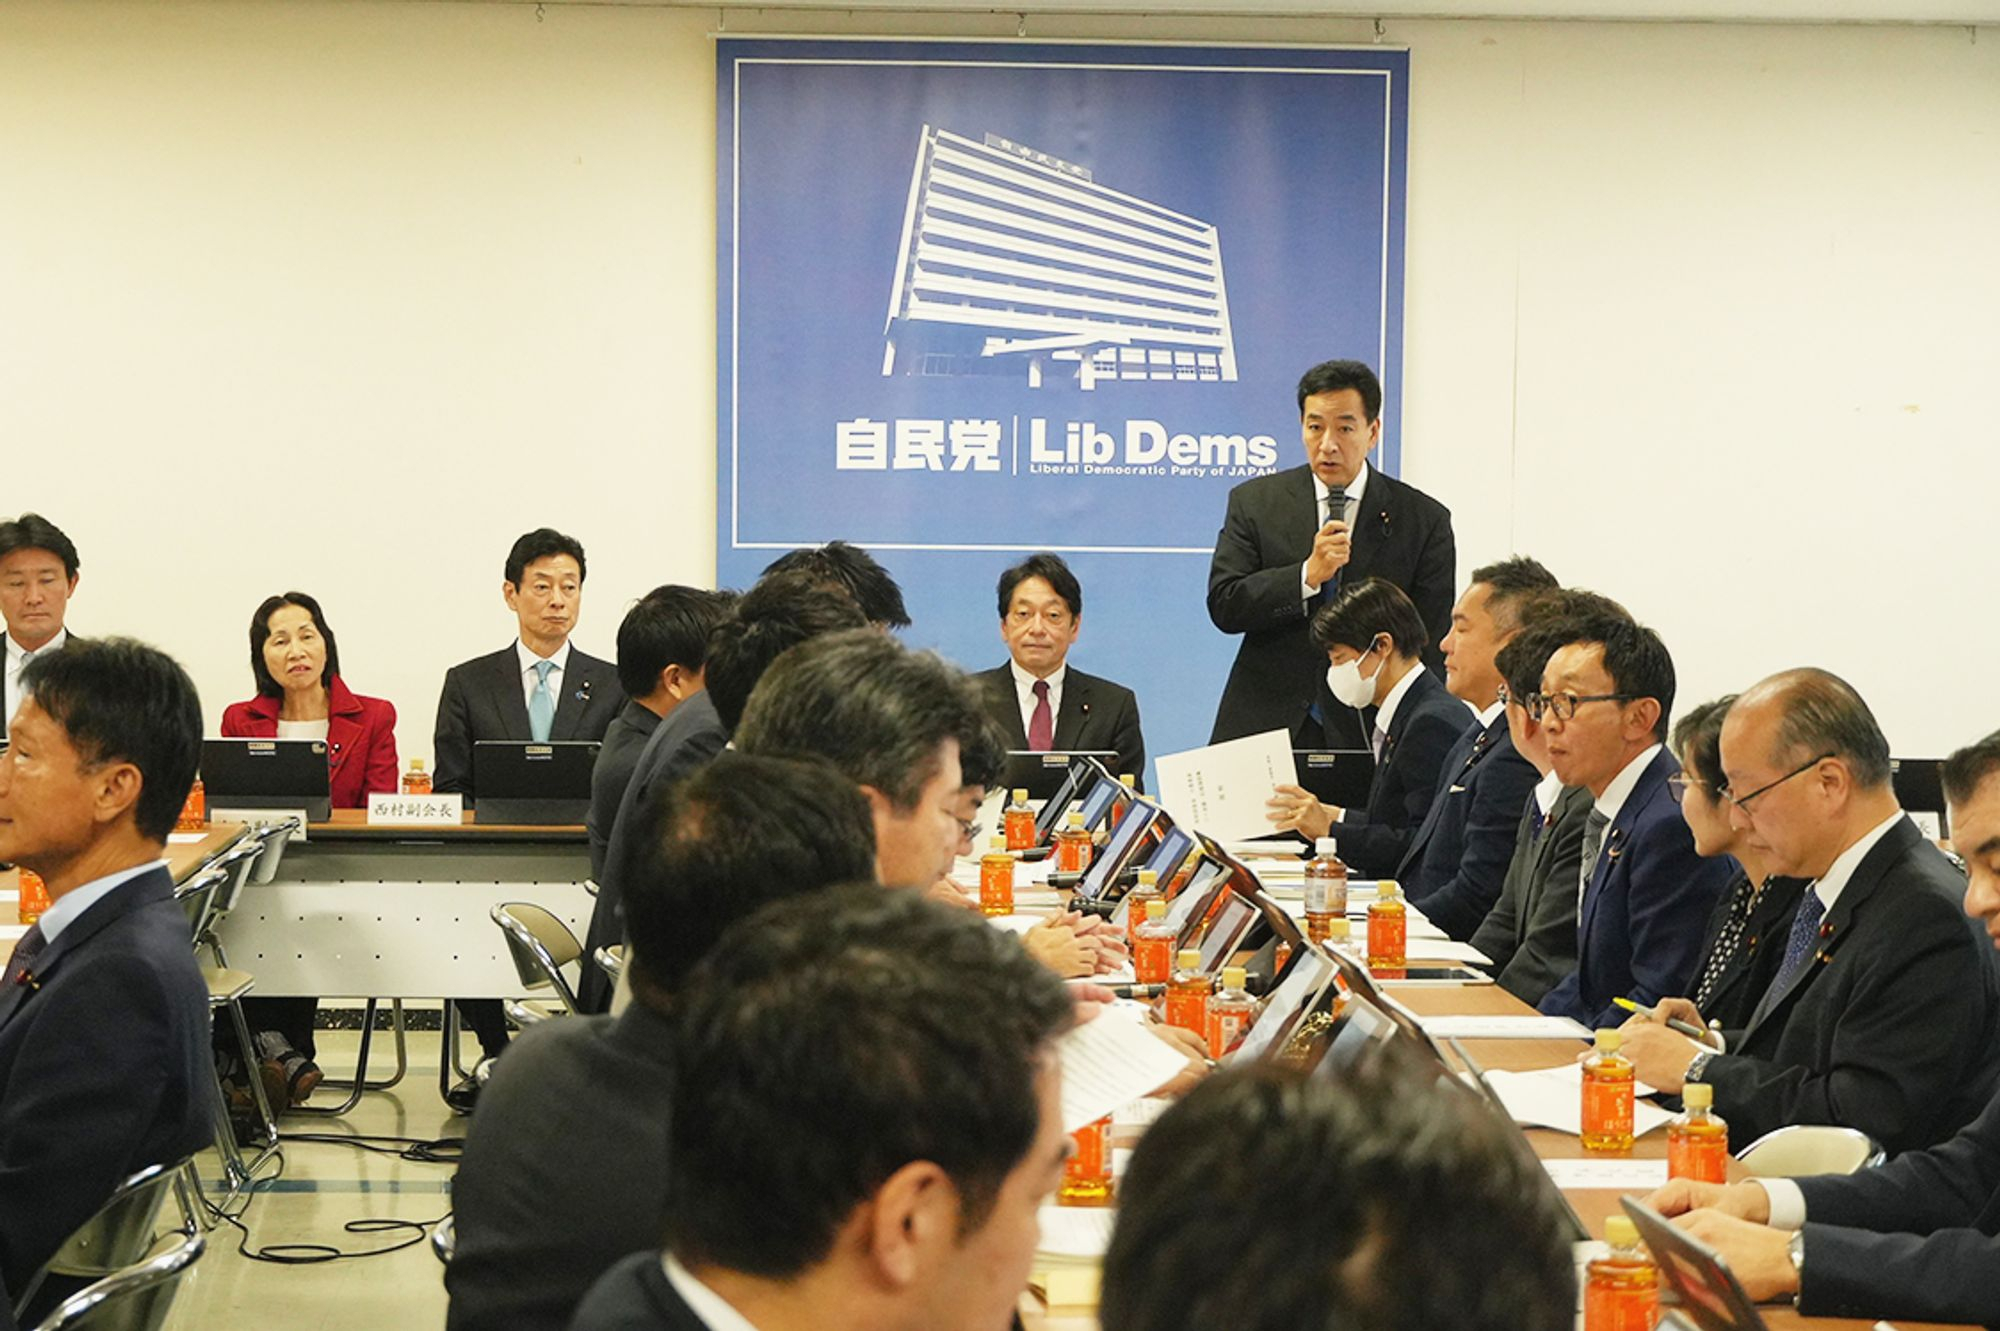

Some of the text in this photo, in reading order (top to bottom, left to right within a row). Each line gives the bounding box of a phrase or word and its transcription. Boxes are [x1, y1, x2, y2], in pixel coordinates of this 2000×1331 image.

[836, 418, 1001, 472] 自民党
[1030, 418, 1278, 467] Lib Dems
[1030, 464, 1277, 478] Liberal Democratic Party of JAPAN
